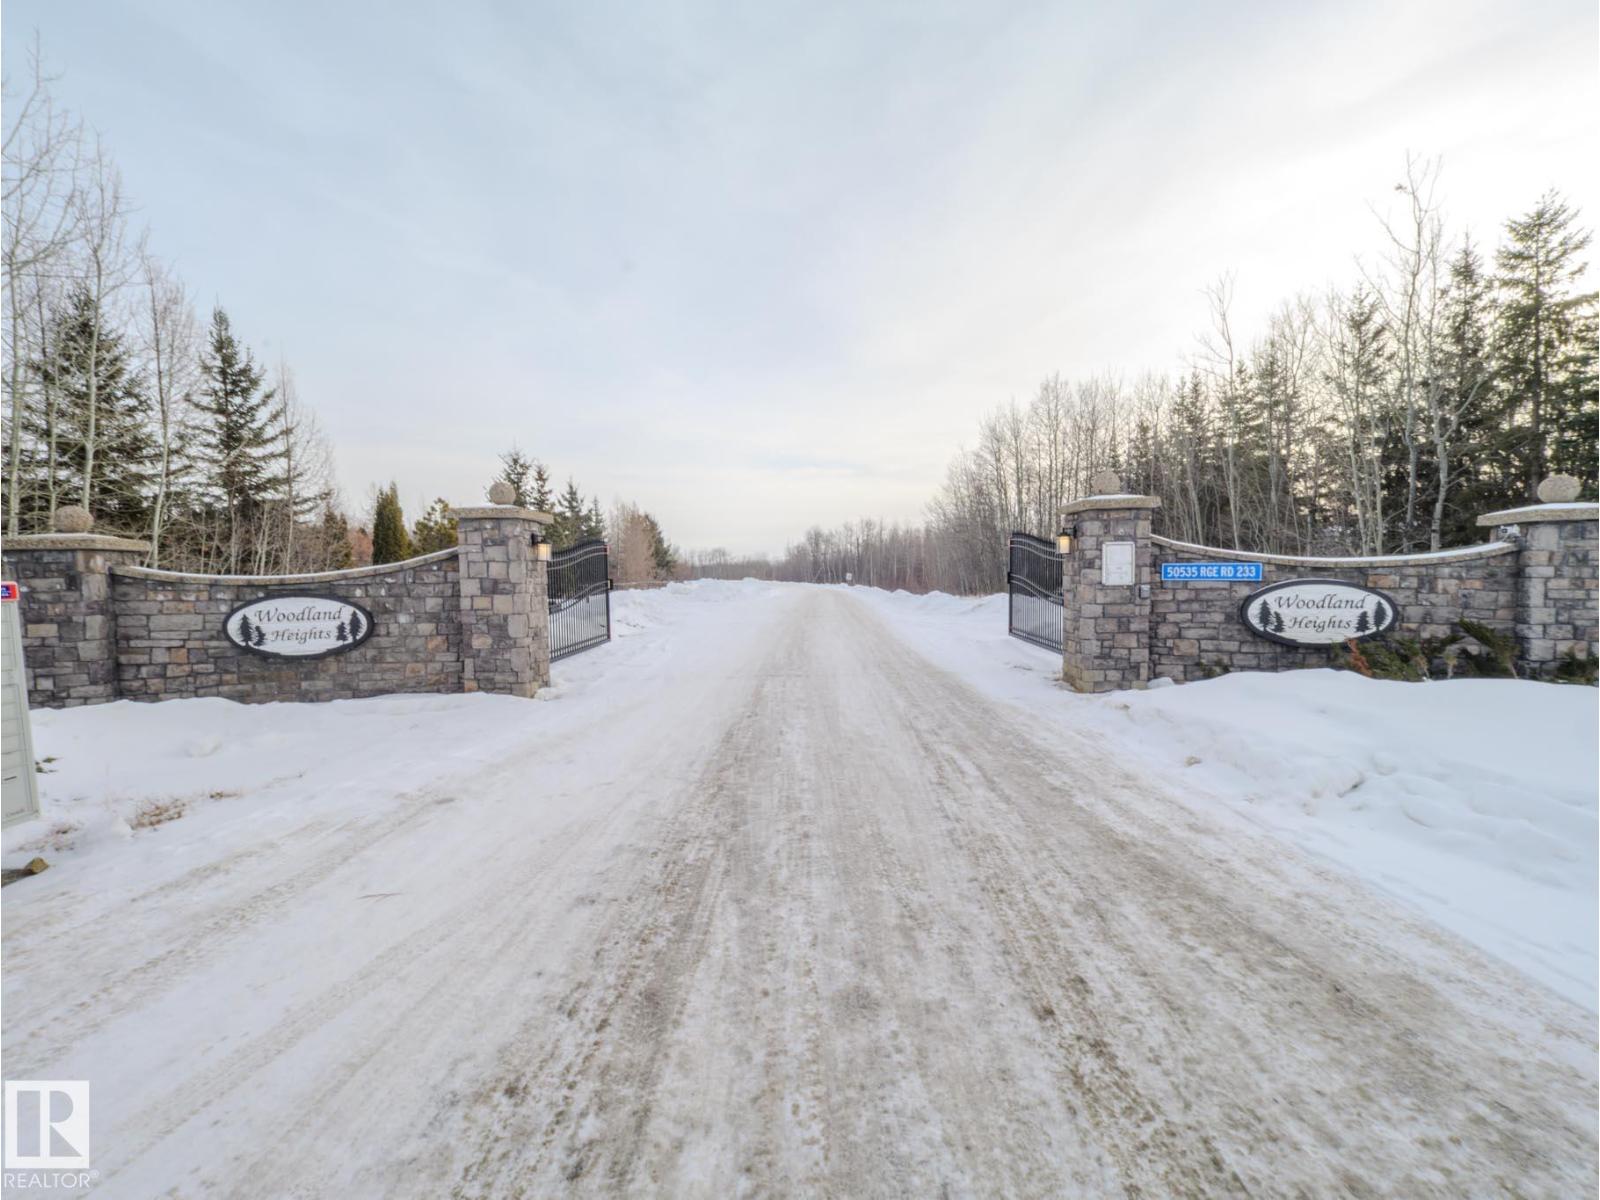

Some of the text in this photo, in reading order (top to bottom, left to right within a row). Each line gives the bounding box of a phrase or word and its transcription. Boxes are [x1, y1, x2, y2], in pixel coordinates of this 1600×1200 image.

[1167, 566, 1256, 577] 50535 RGE RD 233
[1274, 593, 1370, 609] Woodland
[254, 606, 346, 623] Woodland
[1288, 615, 1352, 633] Heights
[270, 629, 332, 644] Heights
